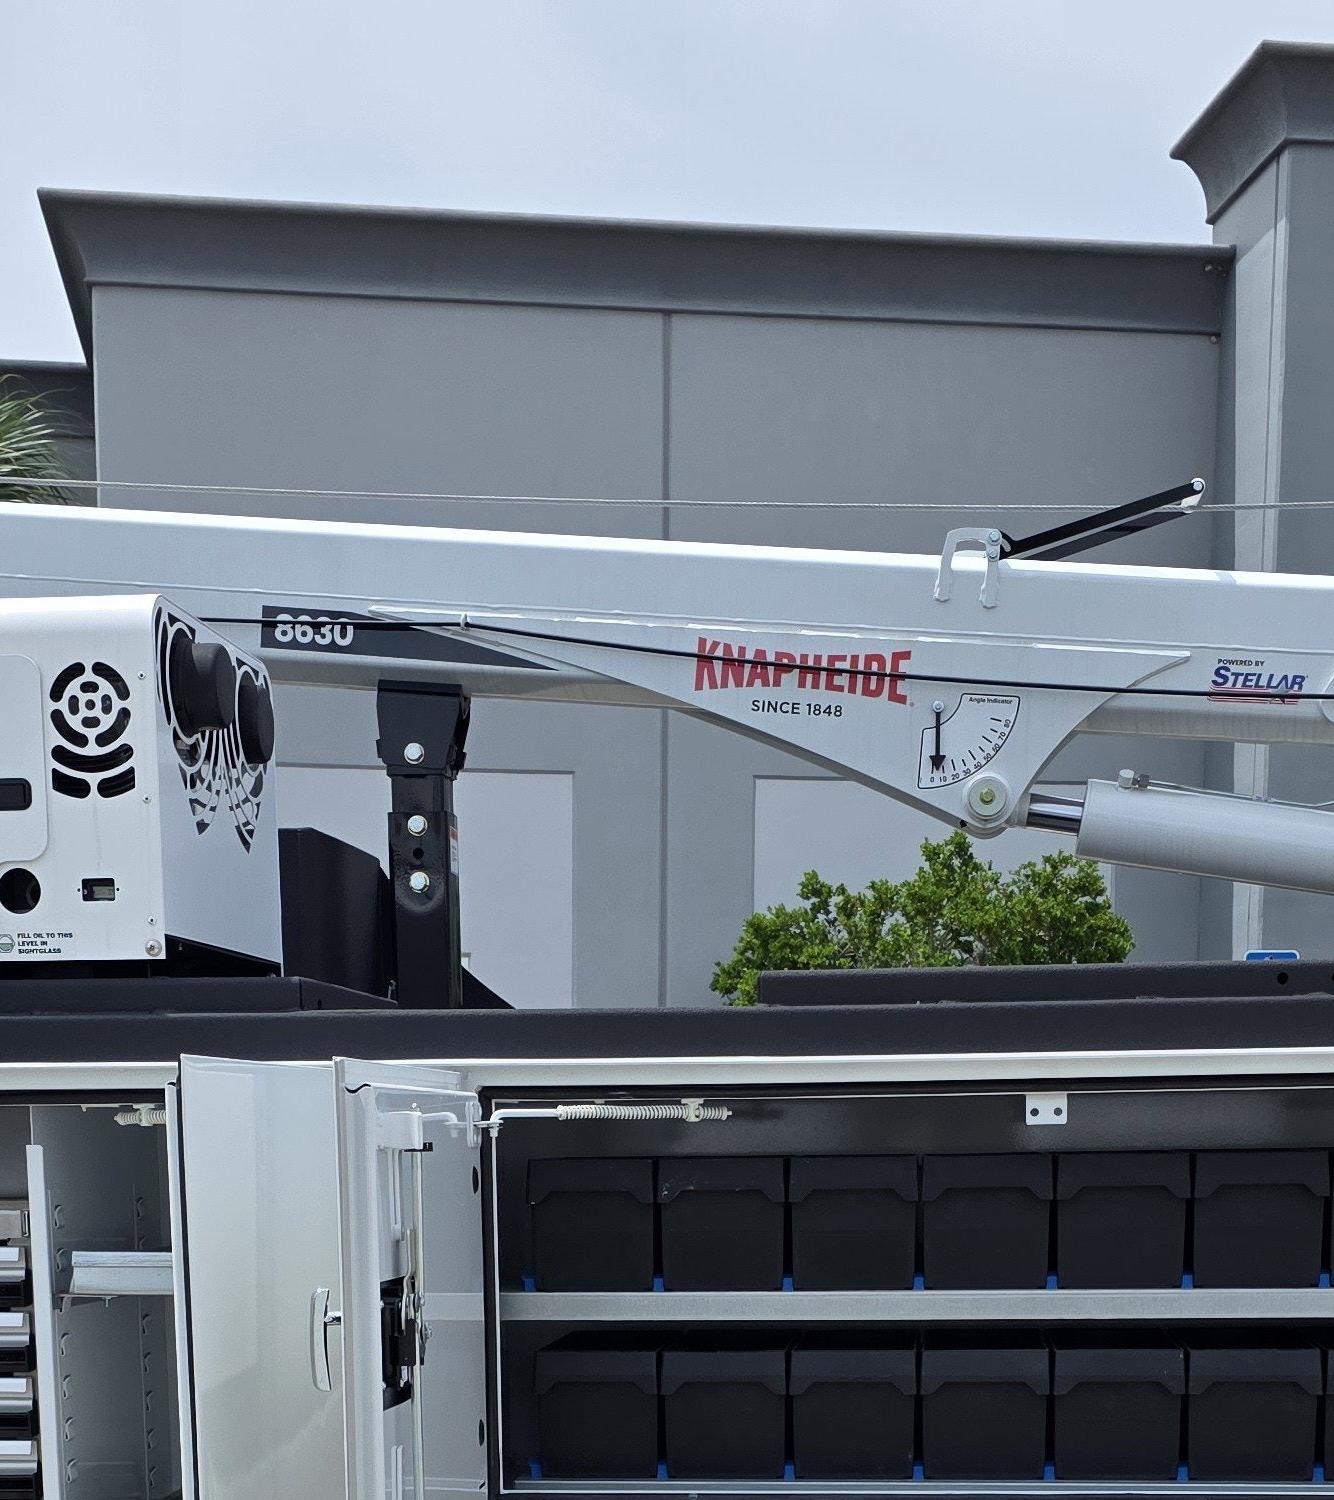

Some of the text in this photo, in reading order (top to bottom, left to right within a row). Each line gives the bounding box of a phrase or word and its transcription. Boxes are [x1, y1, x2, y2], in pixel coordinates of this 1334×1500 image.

[274, 613, 354, 647] 8630
[694, 637, 912, 706] KNAPHEIDE
[1217, 658, 1254, 667] POWERED
[1211, 665, 1306, 691] STELLAR
[750, 700, 843, 718] SINCE 1848
[968, 696, 1013, 705] Angle Indicator
[951, 772, 961, 781] 20
